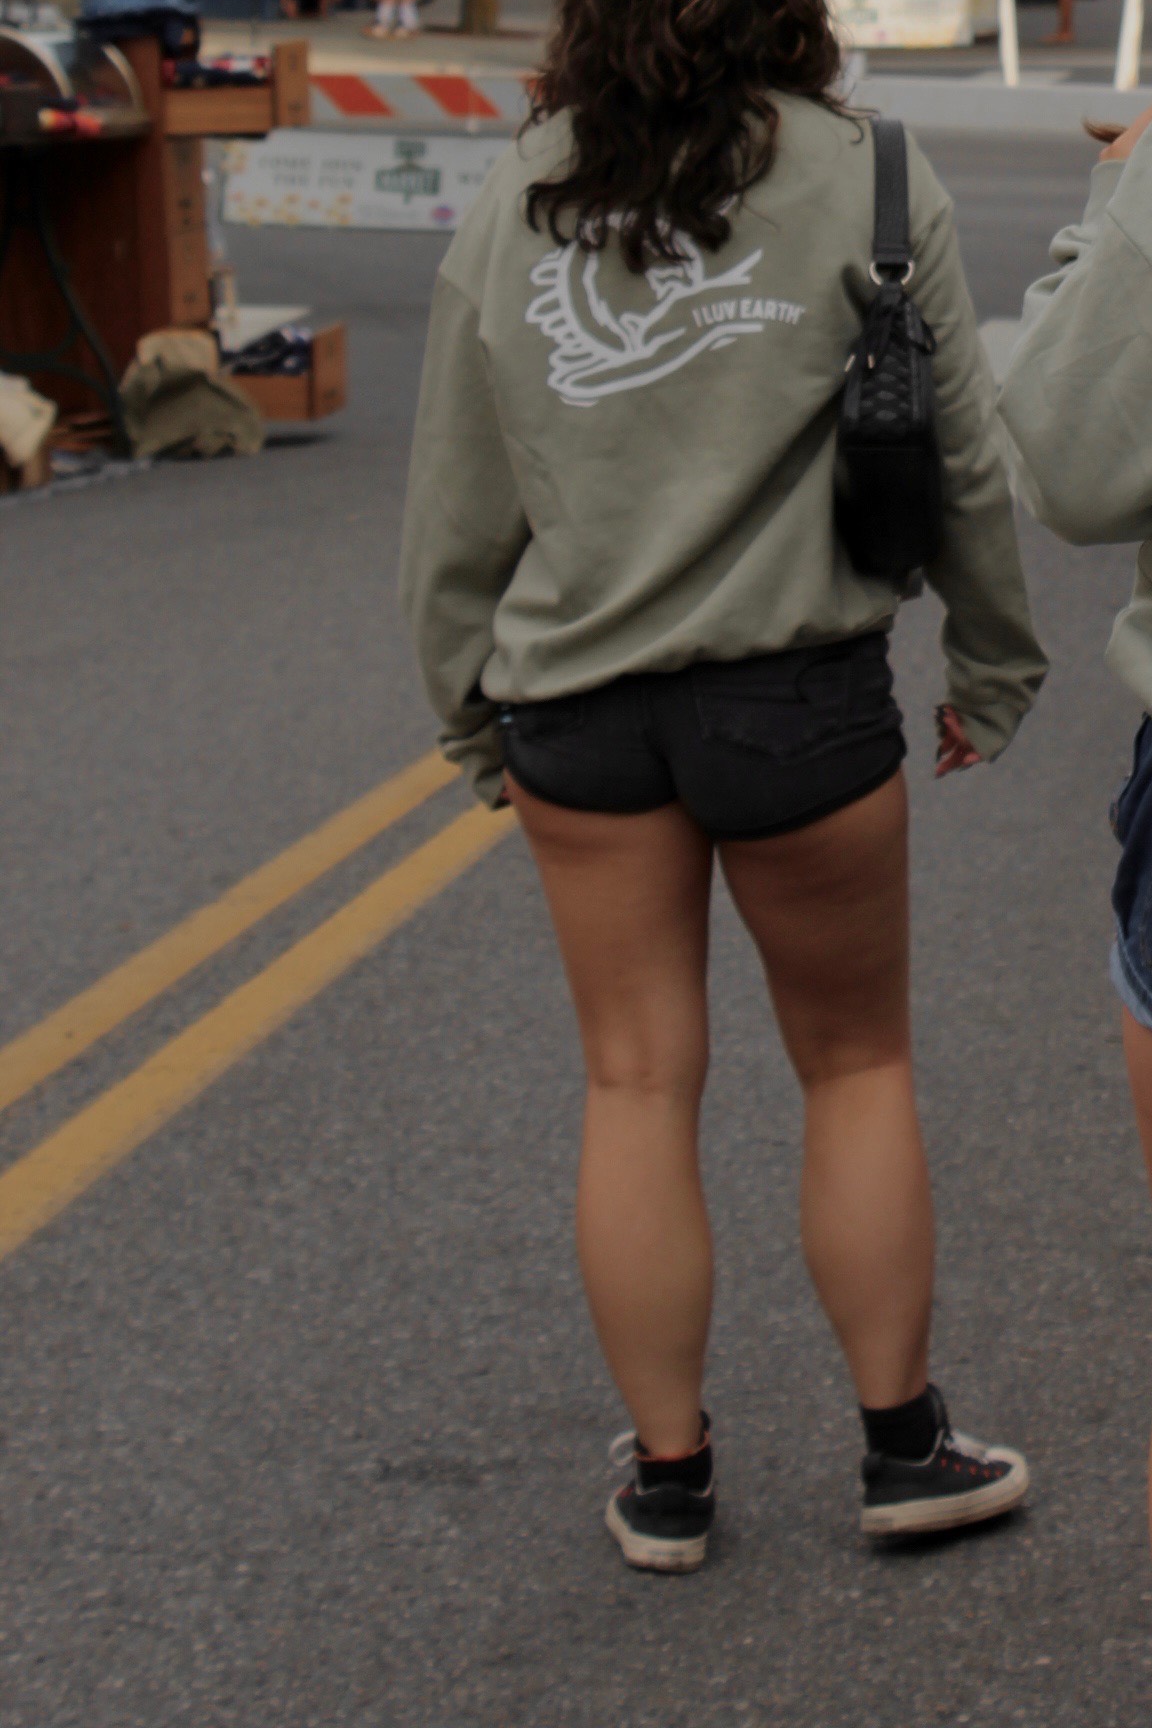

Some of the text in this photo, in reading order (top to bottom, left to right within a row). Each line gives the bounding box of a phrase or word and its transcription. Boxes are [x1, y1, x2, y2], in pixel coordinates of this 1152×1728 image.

[692, 297, 800, 328] I LUV EARTH
